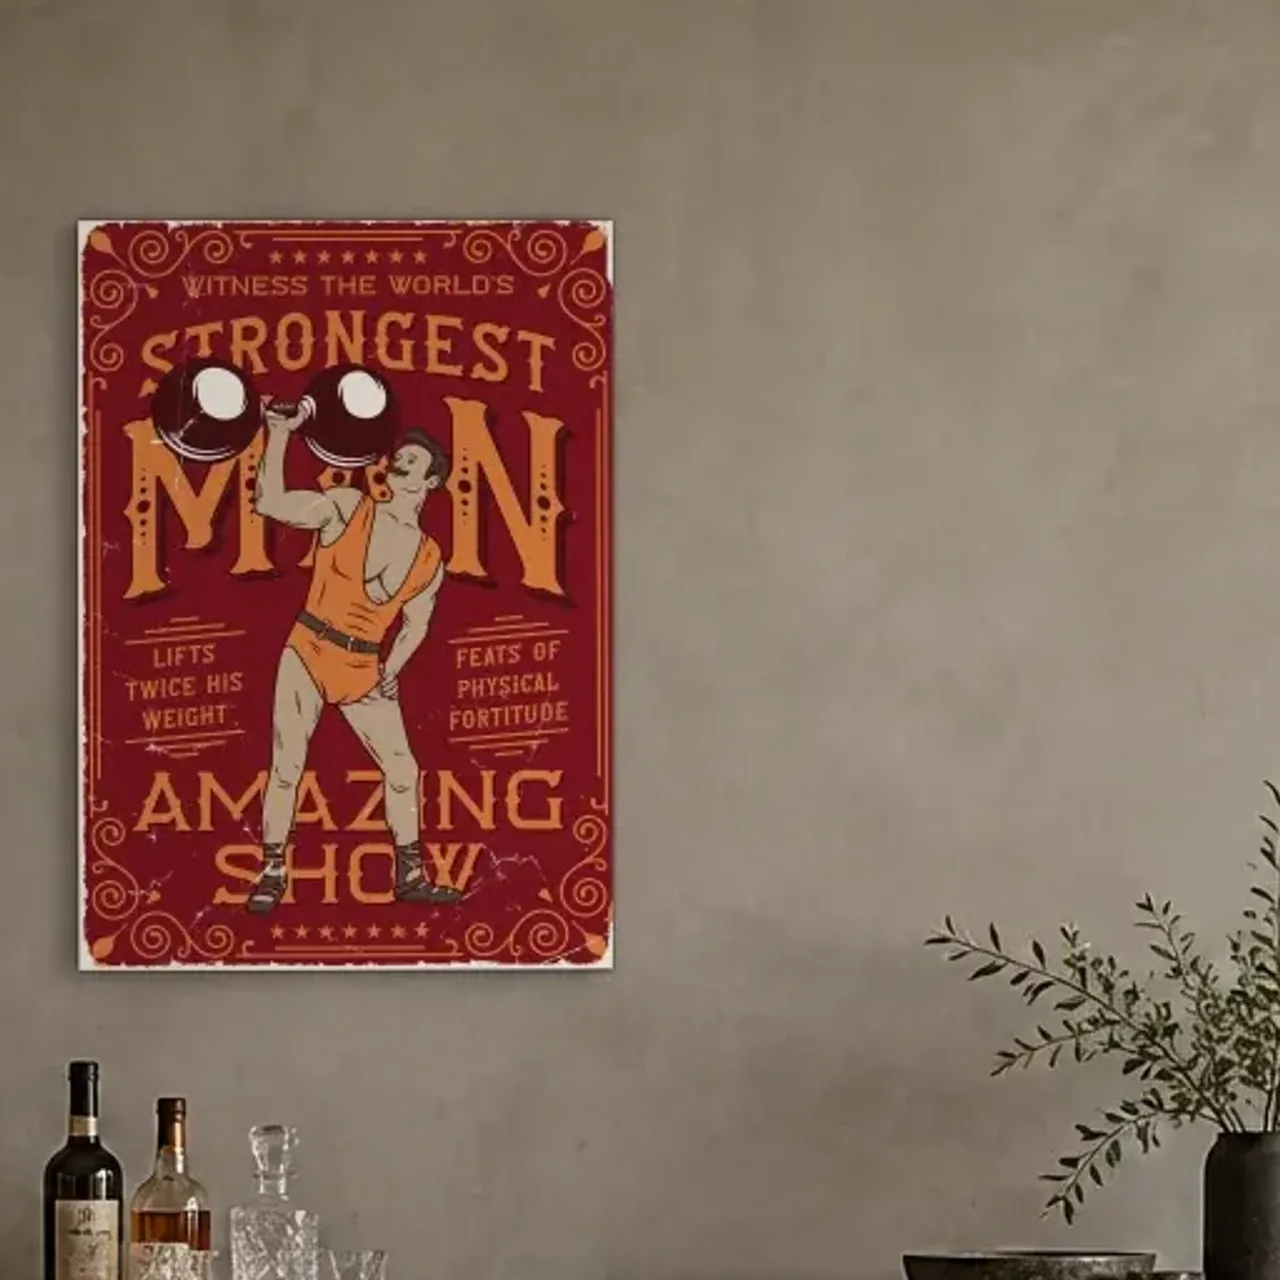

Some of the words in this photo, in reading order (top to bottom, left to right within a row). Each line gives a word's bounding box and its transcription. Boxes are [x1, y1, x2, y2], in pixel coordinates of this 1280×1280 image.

[181, 274, 308, 297] WITNESS
[320, 274, 376, 296] THE
[388, 274, 514, 296] WORLD'S
[122, 396, 566, 599] MN
[153, 643, 216, 668] LIFTS
[456, 642, 522, 669] FEATS
[533, 640, 561, 662] OF
[124, 677, 196, 701] TWICE
[207, 671, 244, 694] HIS
[457, 672, 560, 699] PHYSICAL
[142, 704, 228, 731] WEIGHT
[449, 701, 569, 731] FORTITUDE
[213, 843, 482, 904] SHOW
